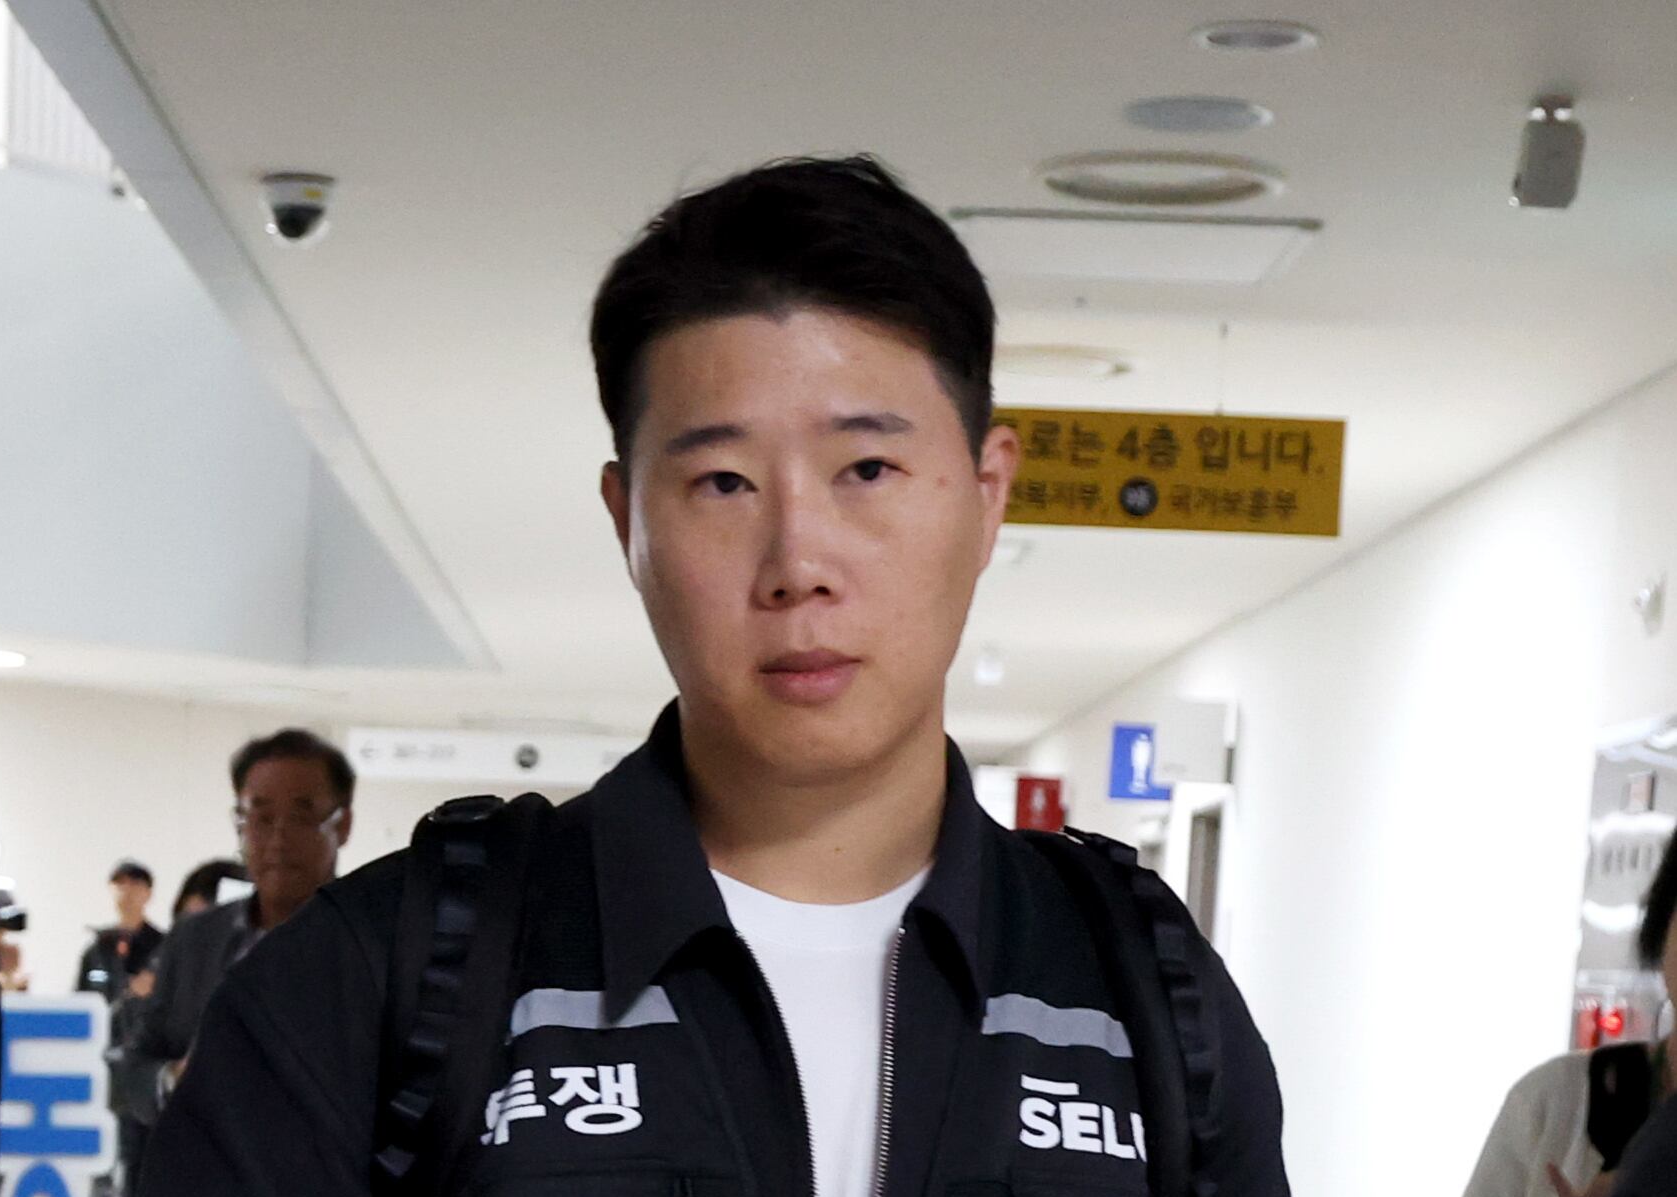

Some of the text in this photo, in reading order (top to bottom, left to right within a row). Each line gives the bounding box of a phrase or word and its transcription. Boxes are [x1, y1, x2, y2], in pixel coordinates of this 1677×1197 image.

[991, 416, 1324, 474] 로는 4층 입니다.
[480, 1063, 644, 1145] 투쟁
